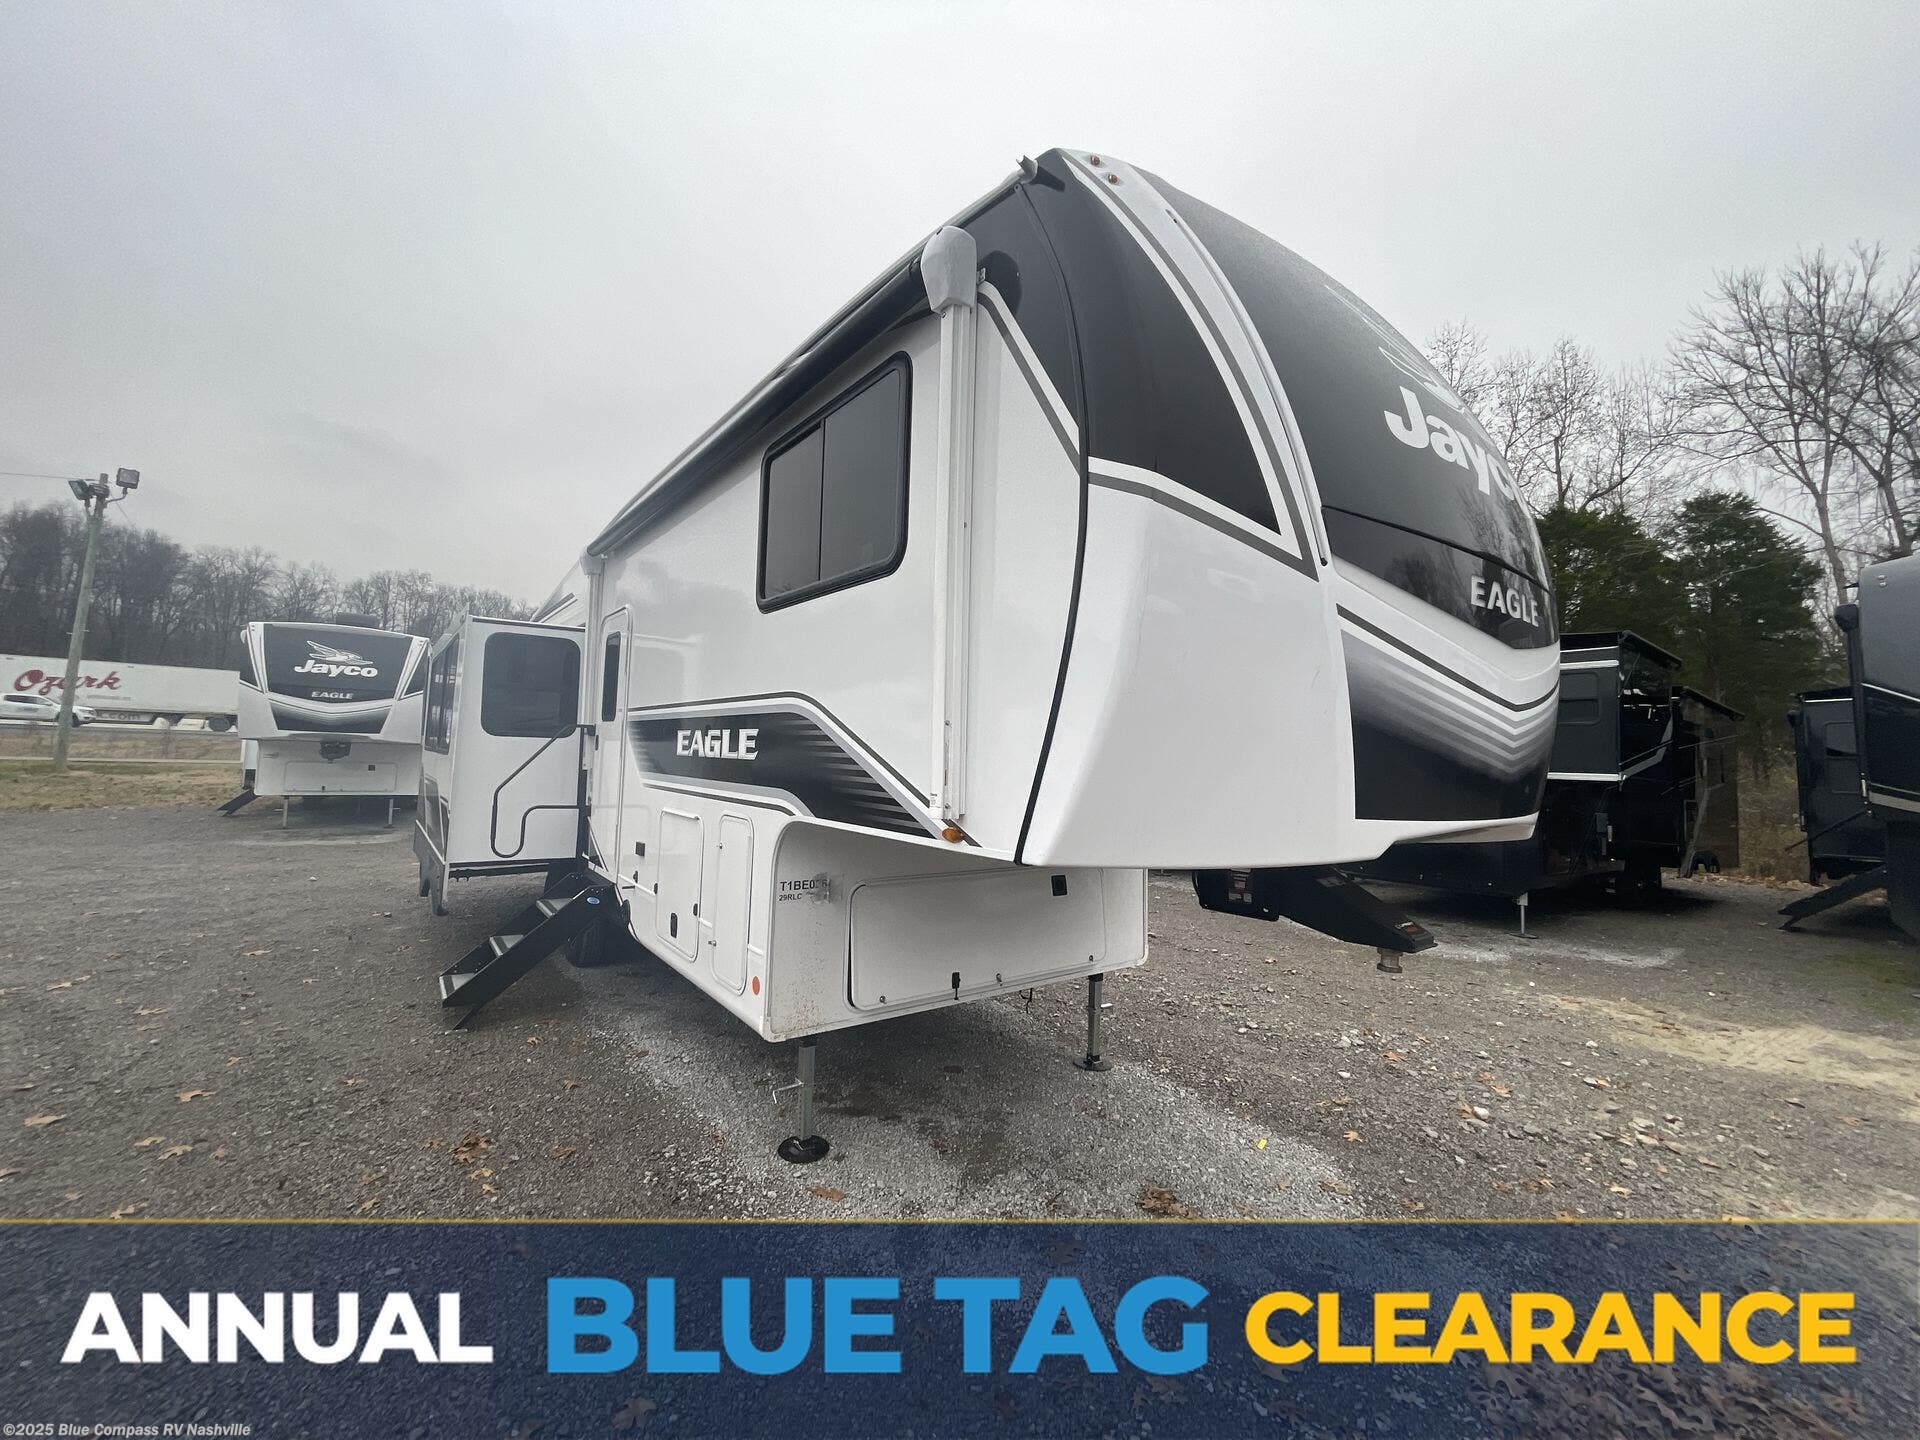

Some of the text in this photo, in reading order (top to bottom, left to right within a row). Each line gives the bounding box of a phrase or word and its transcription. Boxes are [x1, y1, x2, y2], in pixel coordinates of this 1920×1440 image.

[1470, 574, 1539, 628] EAGLE
[294, 659, 378, 678] Jayco
[311, 691, 354, 700] EAGLE
[677, 728, 759, 760] EAGLE
